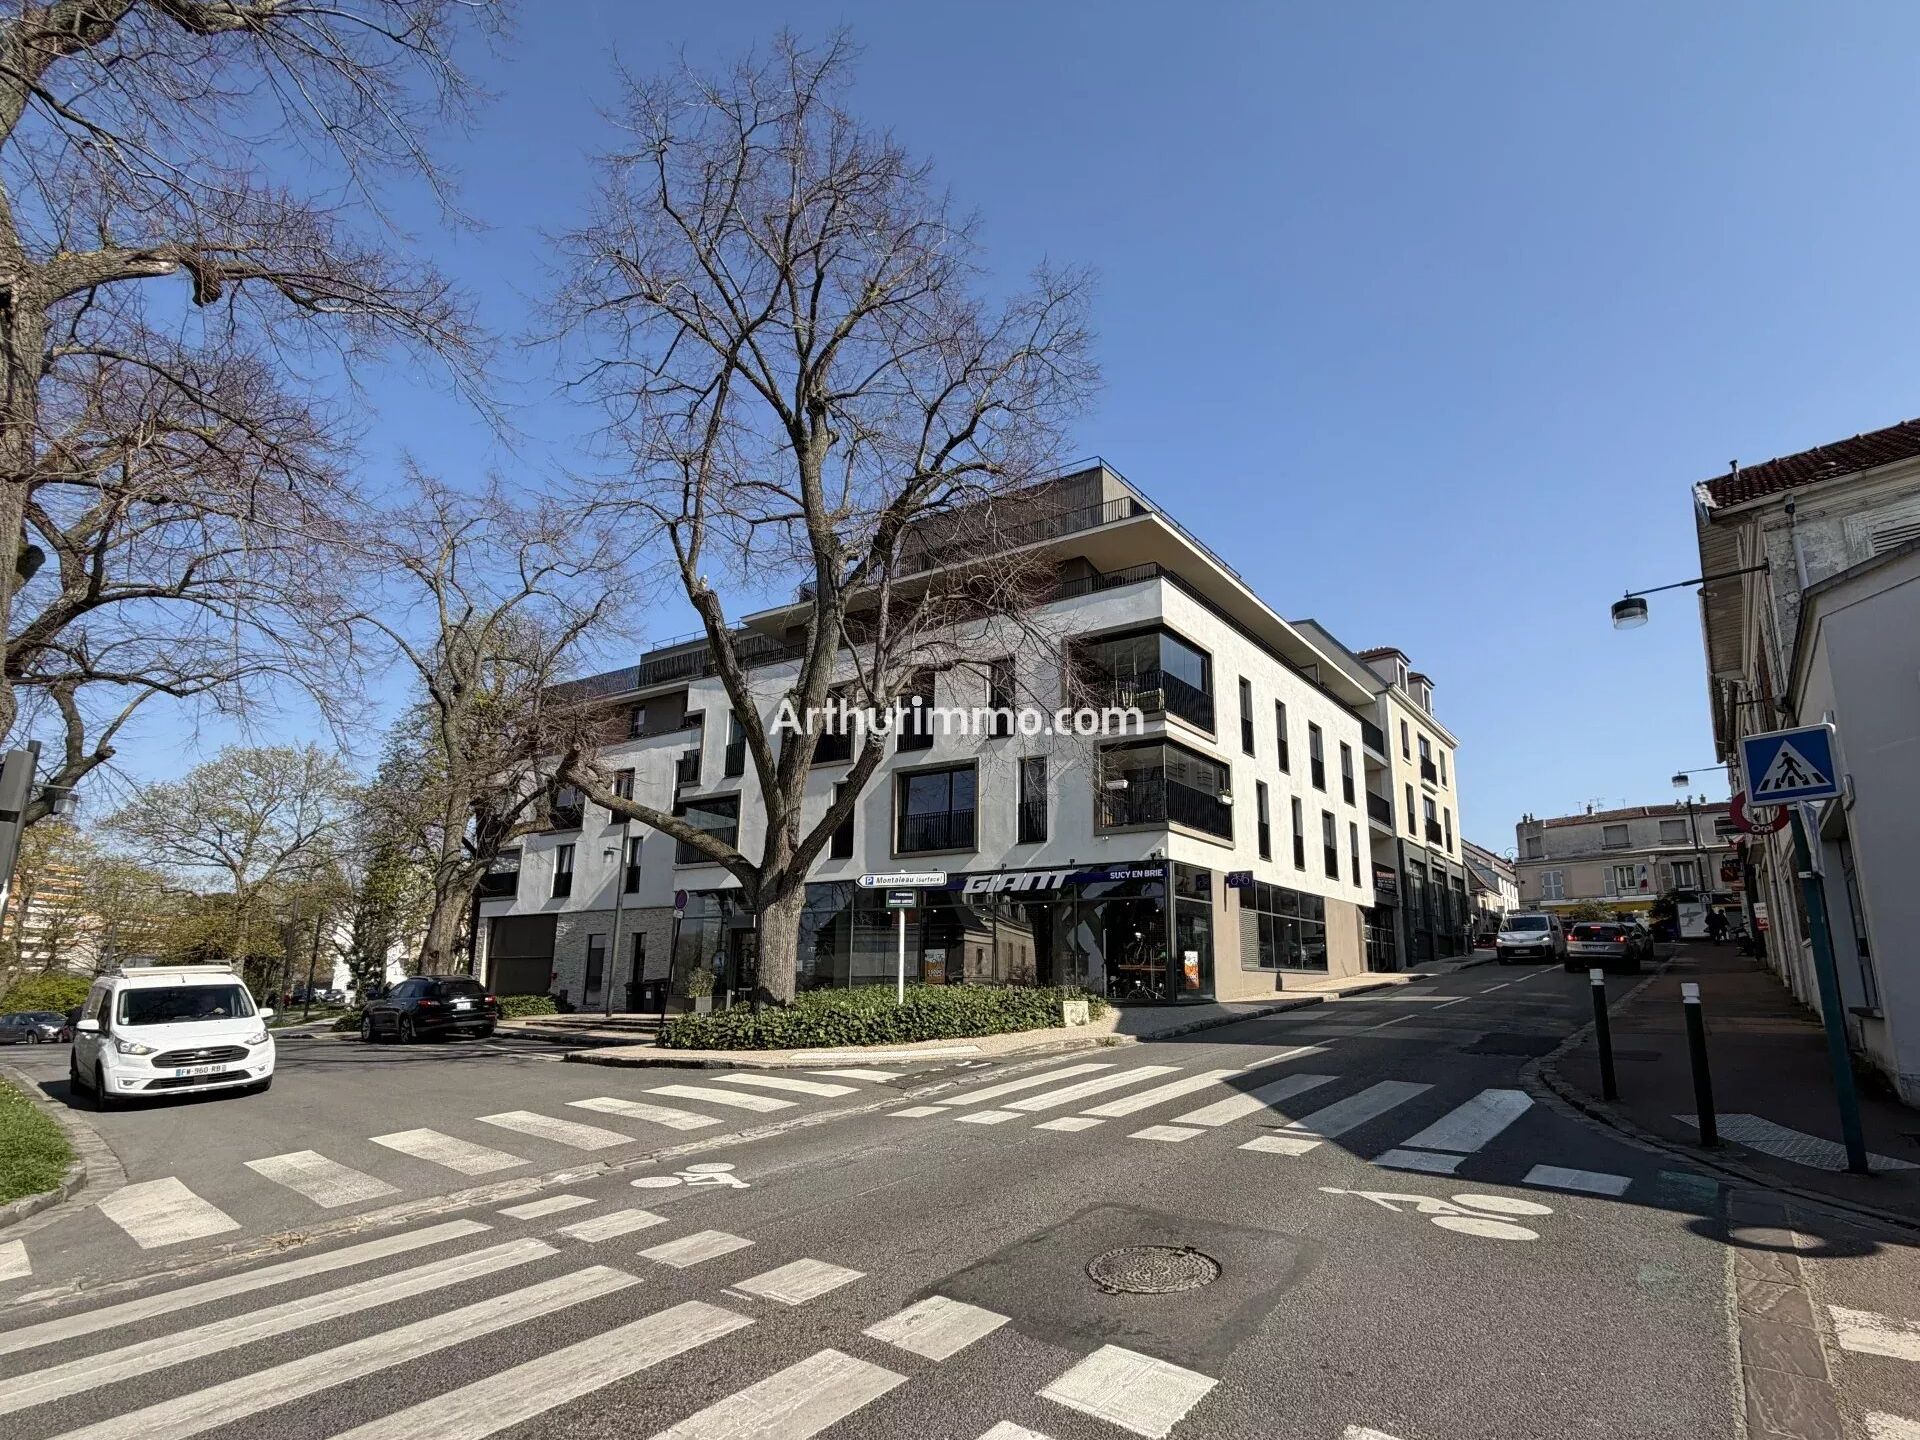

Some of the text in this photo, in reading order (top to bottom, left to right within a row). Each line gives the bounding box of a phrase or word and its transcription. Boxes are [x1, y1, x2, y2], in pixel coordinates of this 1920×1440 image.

[1751, 823, 1774, 833] Orpi
[1110, 868, 1163, 879] SUCY EN BRIE
[962, 869, 1079, 893] GIANT
